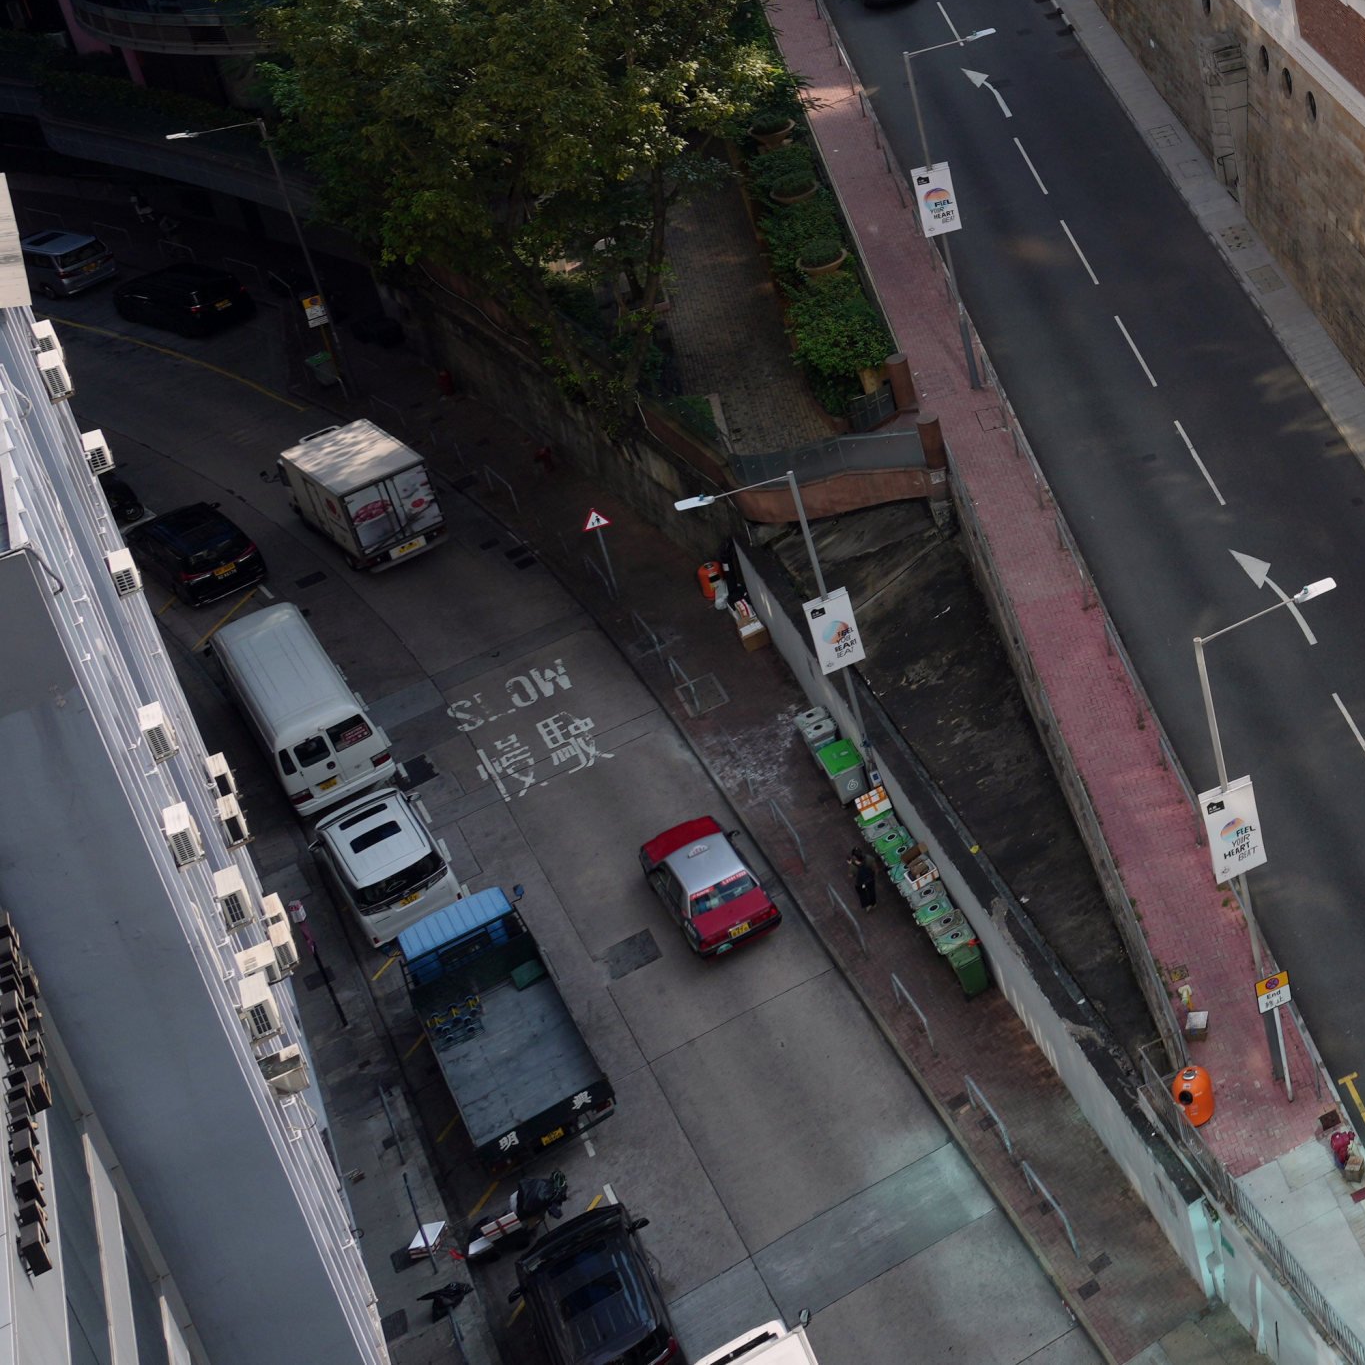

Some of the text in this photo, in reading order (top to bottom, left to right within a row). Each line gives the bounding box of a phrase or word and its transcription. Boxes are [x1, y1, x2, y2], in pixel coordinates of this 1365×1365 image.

[933, 210, 955, 219] HEART
[1235, 825, 1257, 838] FEEL
[1223, 841, 1251, 860] HEART
[1238, 845, 1258, 862] BEAT
[1266, 990, 1281, 1000] End
[498, 1130, 520, 1152] 明
